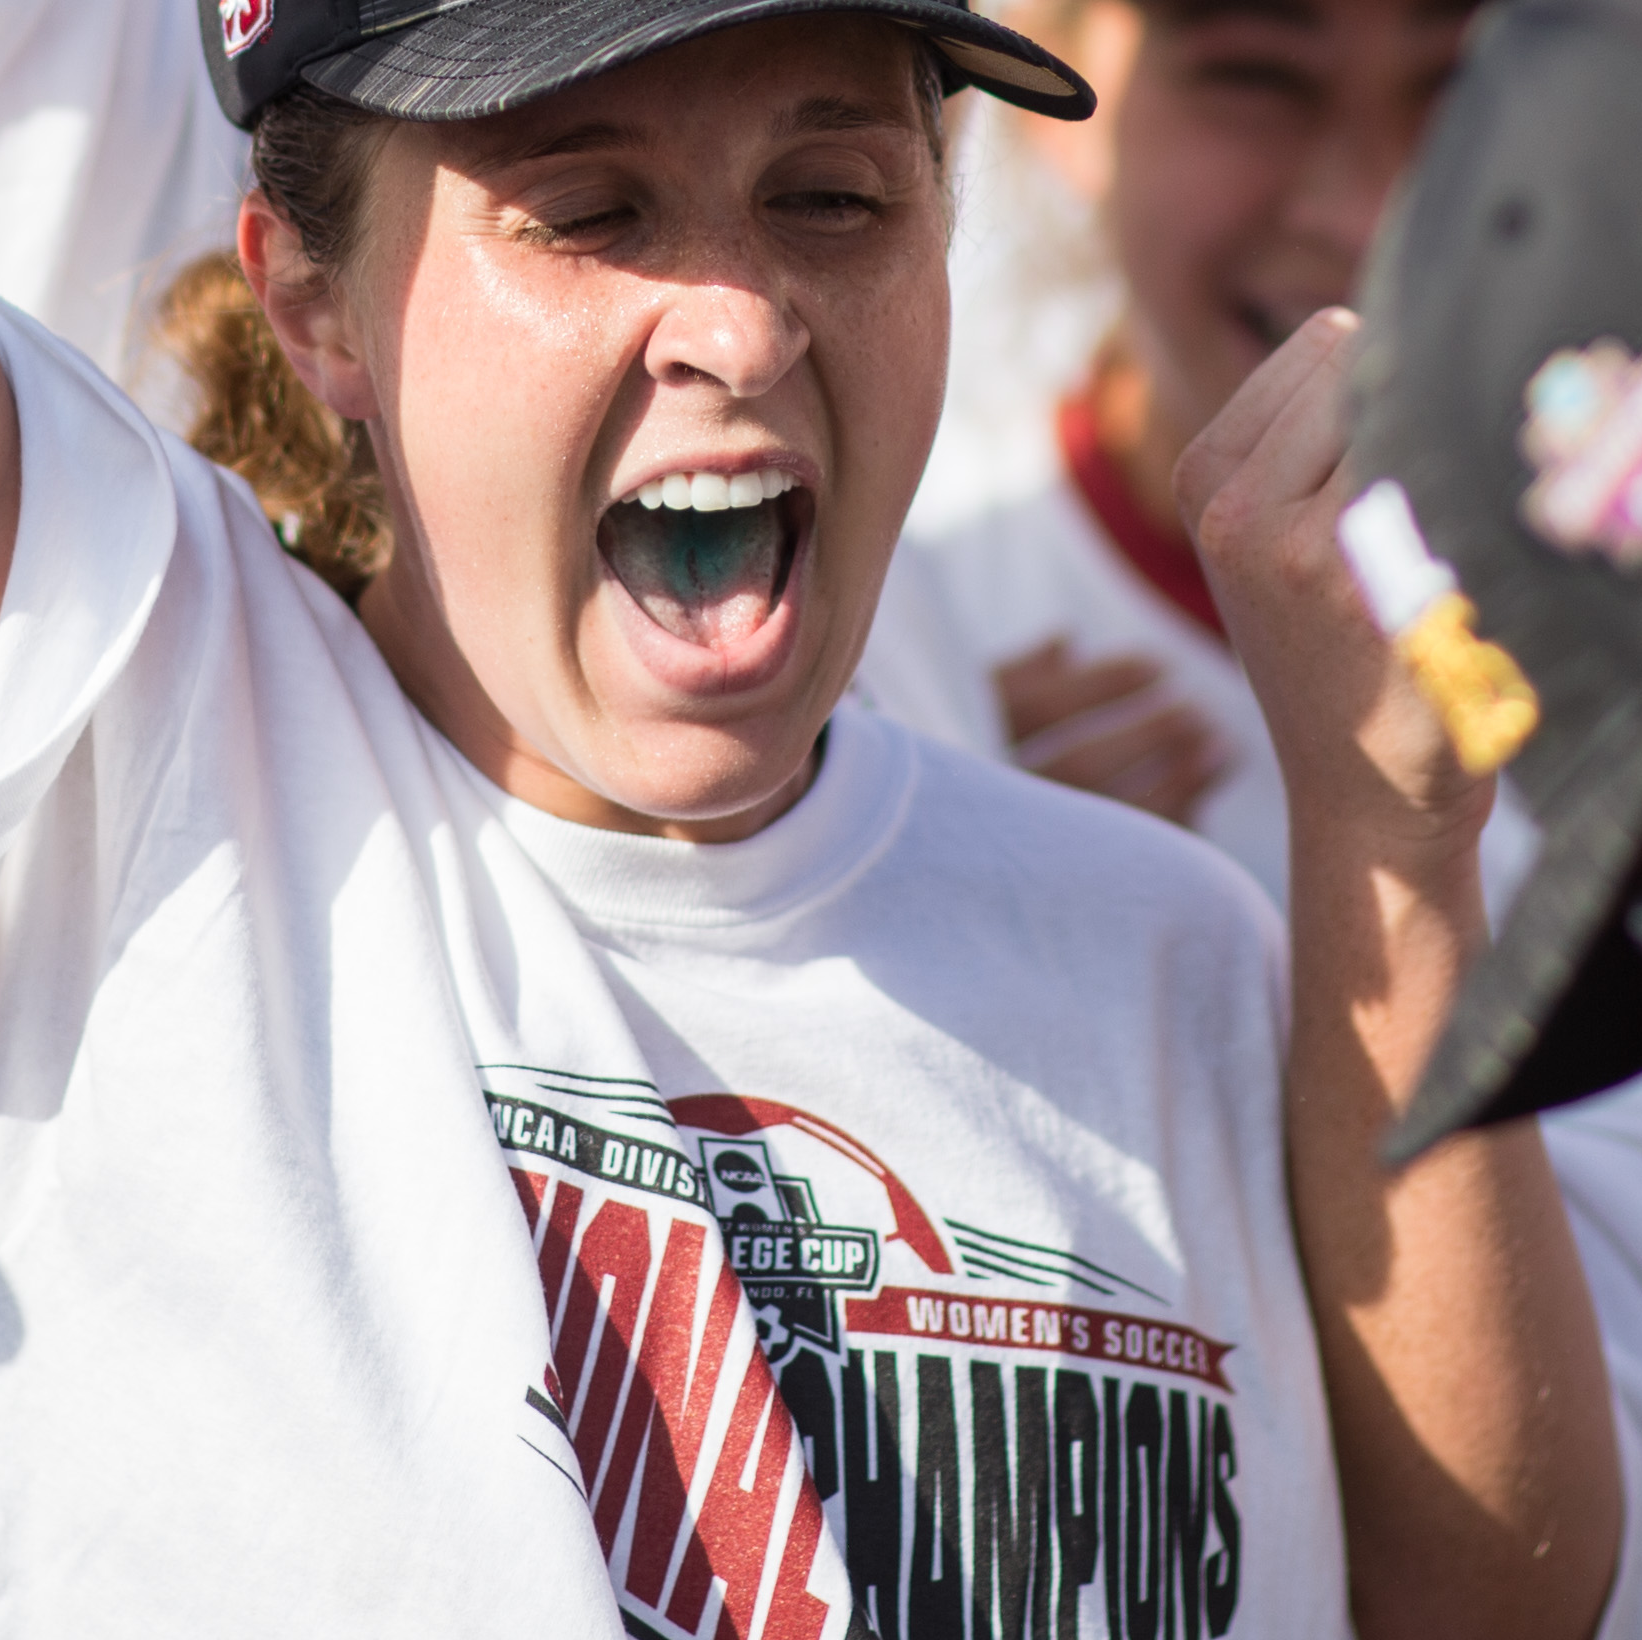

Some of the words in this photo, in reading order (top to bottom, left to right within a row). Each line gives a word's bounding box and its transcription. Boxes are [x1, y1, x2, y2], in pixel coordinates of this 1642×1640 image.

[800, 1238, 865, 1274] CUP
[906, 1296, 1091, 1350] WOMEN'S
[1103, 1320, 1211, 1375] SOCCER
